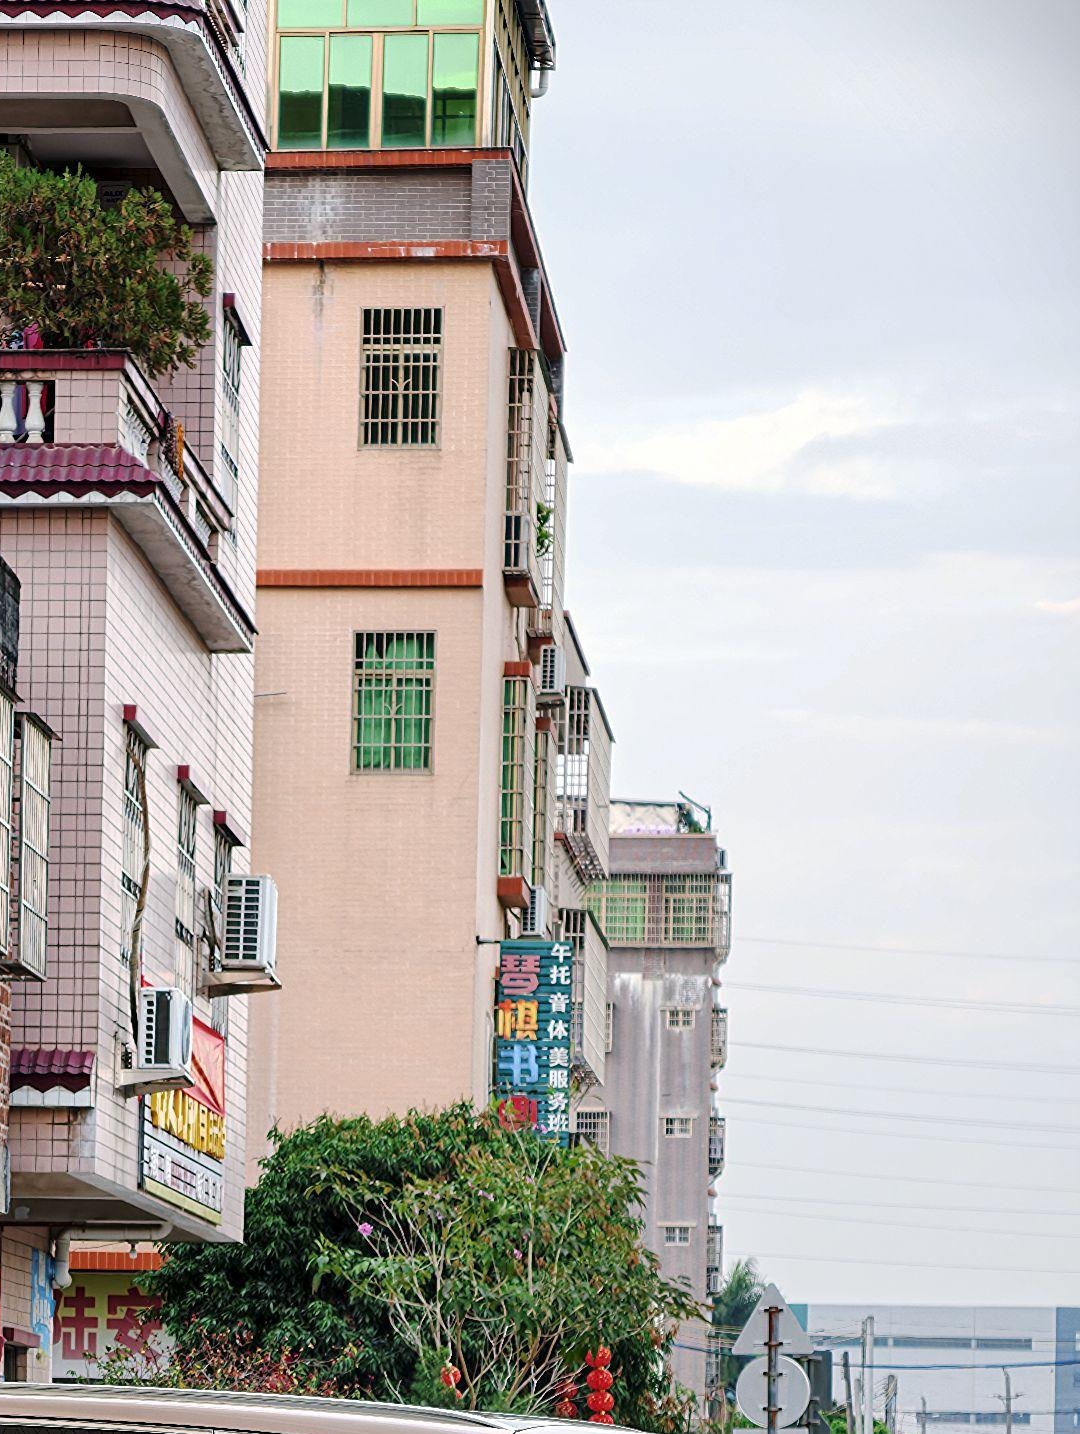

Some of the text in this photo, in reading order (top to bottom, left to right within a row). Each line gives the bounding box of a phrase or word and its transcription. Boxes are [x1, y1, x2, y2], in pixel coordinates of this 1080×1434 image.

[546, 942, 572, 1132] 午托音体美服务班
